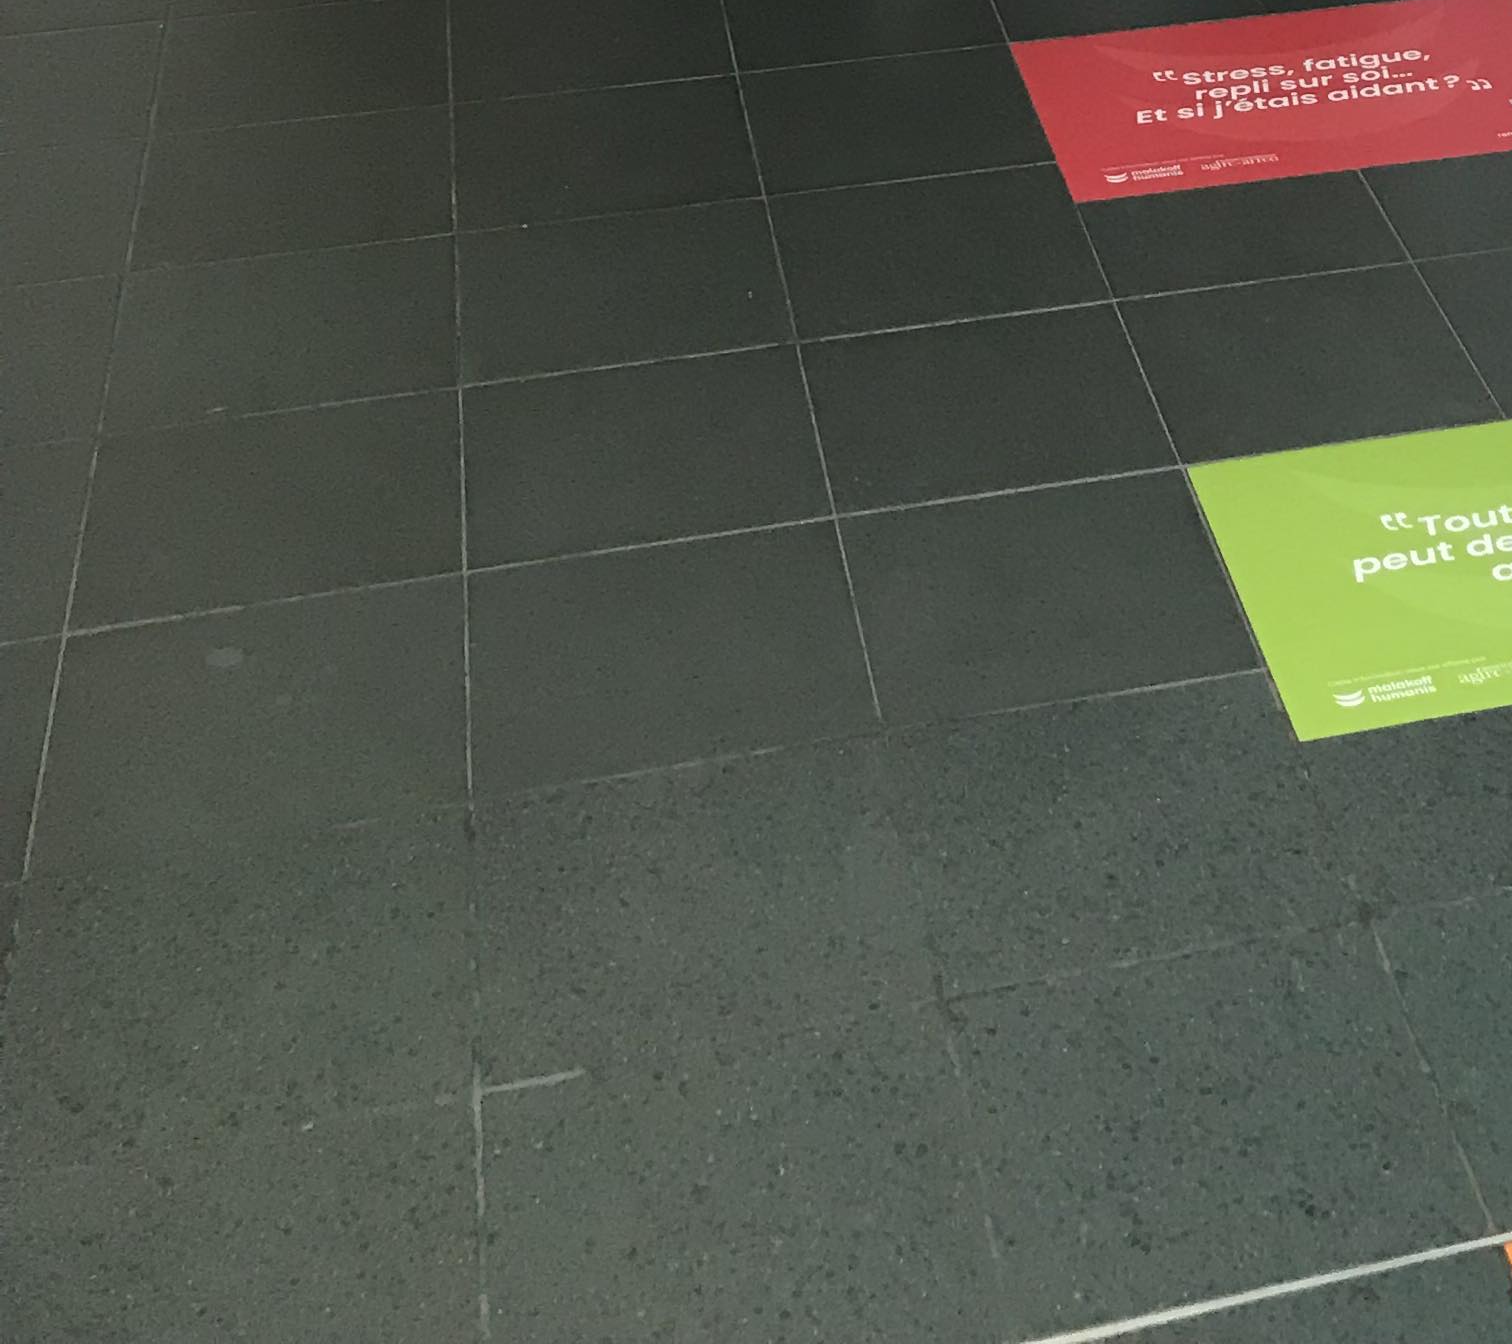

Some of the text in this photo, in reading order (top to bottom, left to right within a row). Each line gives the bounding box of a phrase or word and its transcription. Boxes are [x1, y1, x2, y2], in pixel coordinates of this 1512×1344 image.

[1303, 48, 1432, 73] fatigue,
[1196, 77, 1270, 101] repli
[1280, 73, 1333, 92] sur
[1136, 107, 1167, 125] Et
[1177, 102, 1205, 120] si
[1328, 76, 1439, 102] aidant
[1352, 540, 1456, 583] peut
[1367, 675, 1434, 696] malakoff
[1370, 684, 1437, 704] humanis
